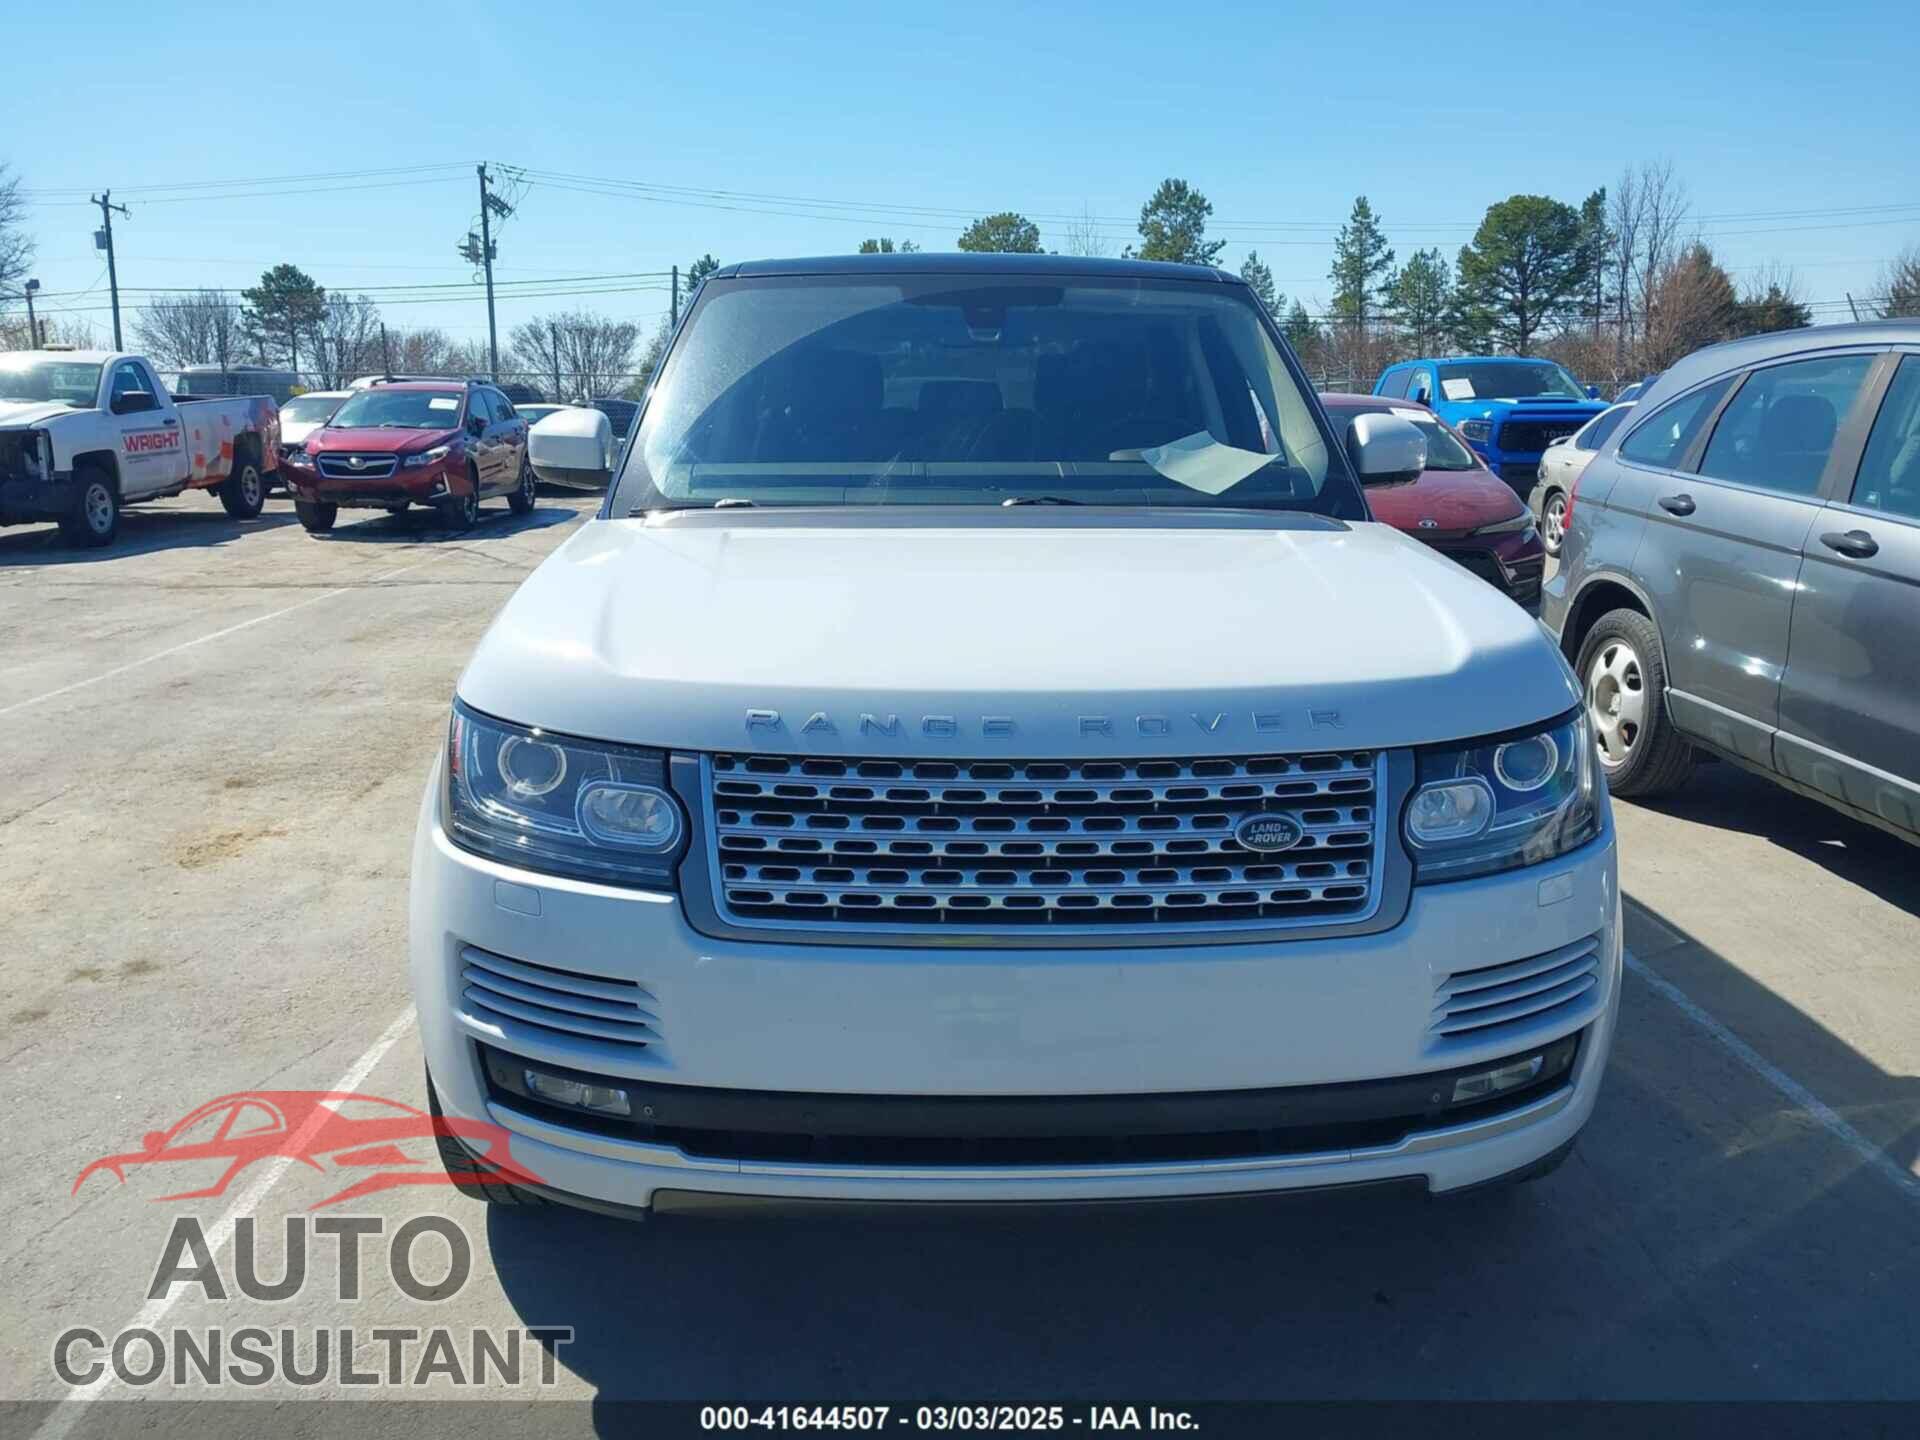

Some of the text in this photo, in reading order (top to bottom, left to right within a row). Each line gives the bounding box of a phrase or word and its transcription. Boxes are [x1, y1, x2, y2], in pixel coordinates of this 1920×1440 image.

[123, 432, 179, 452] WRIGHT
[745, 708, 1344, 738] RANGE ROVER
